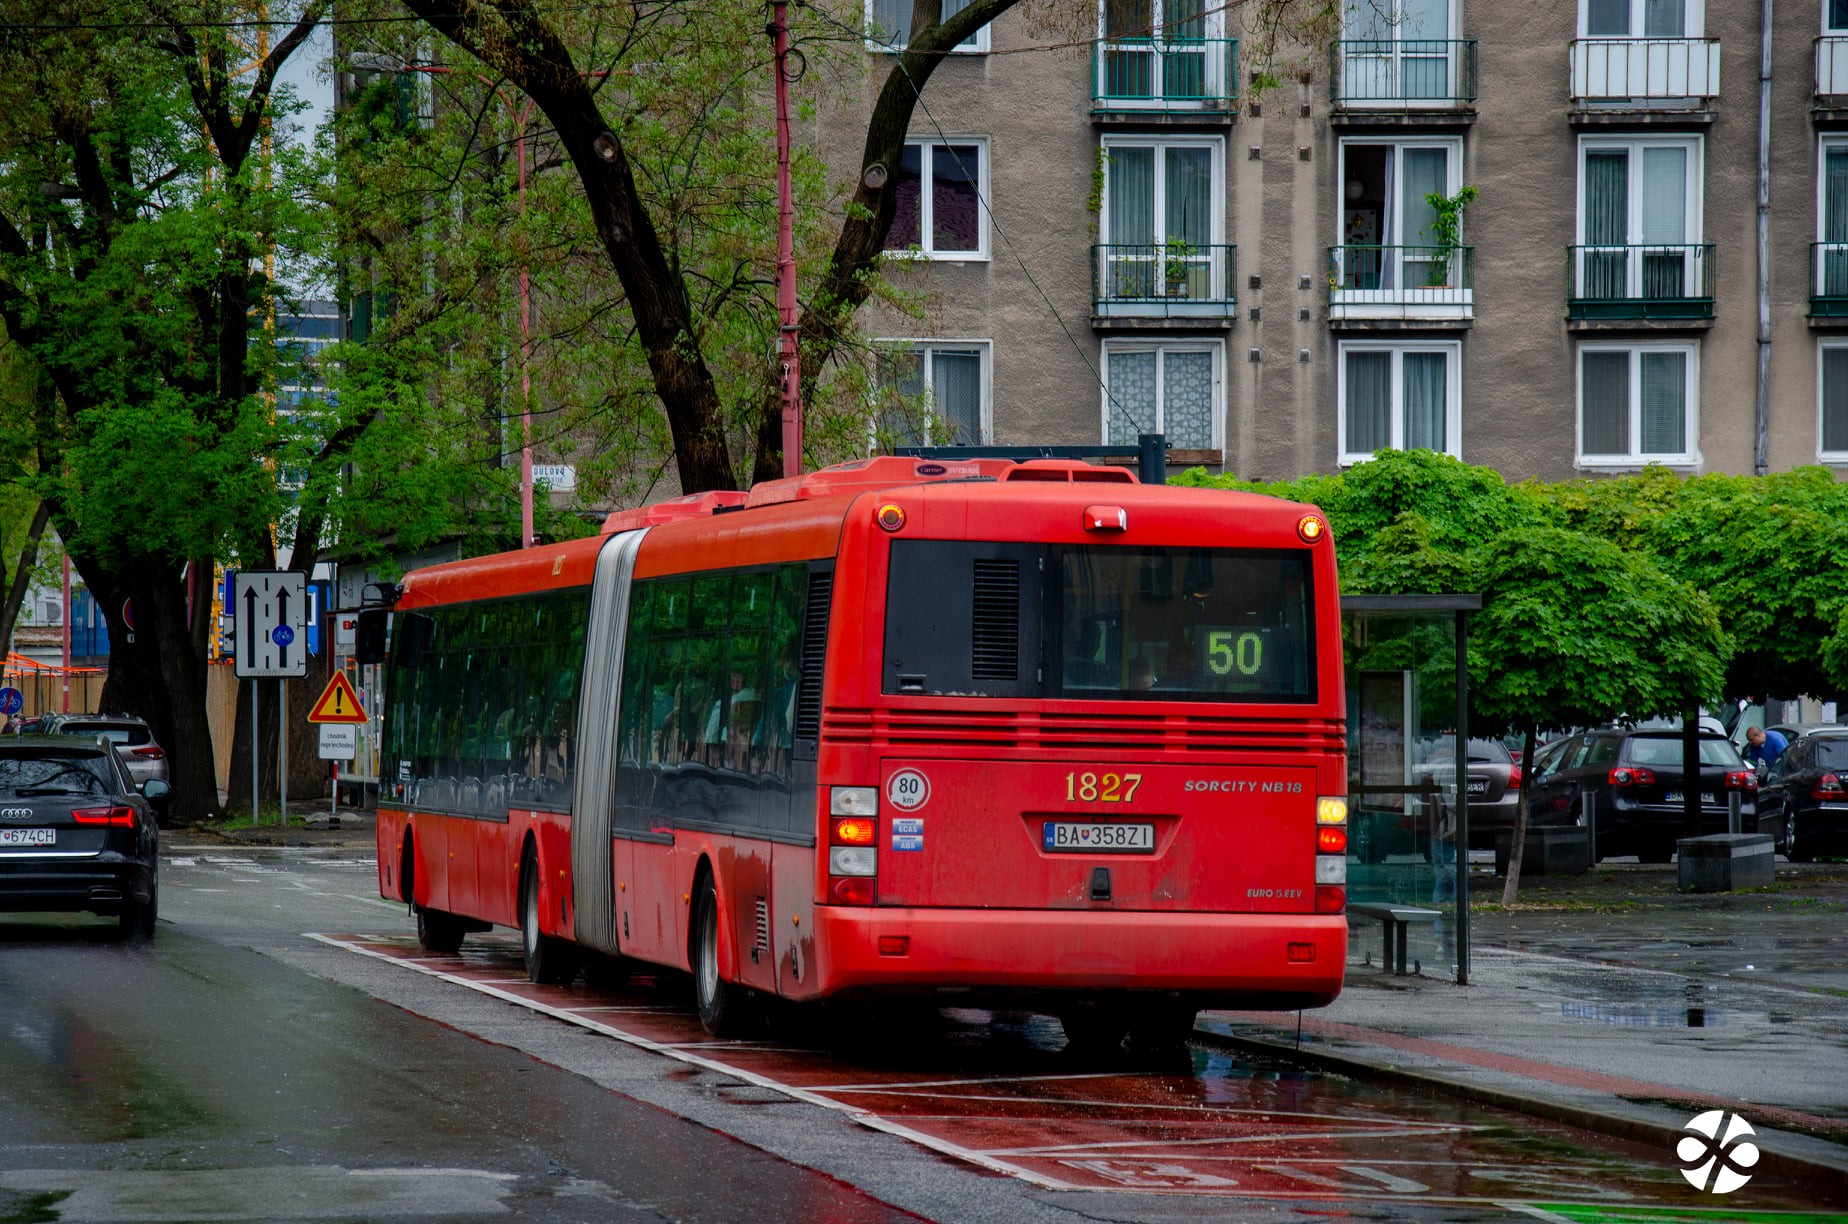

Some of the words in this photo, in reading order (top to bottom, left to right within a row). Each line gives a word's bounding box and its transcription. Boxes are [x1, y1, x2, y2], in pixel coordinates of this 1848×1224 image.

[1209, 632, 1262, 674] 50
[899, 778, 918, 794] 80
[1066, 772, 1142, 802] 1827
[1184, 780, 1257, 792] SORCITY
[903, 796, 914, 804] km
[898, 825, 918, 833] ECAS
[1091, 826, 1147, 846] 358ZI
[1247, 888, 1274, 898] EURO
[1276, 889, 1282, 898] 5
